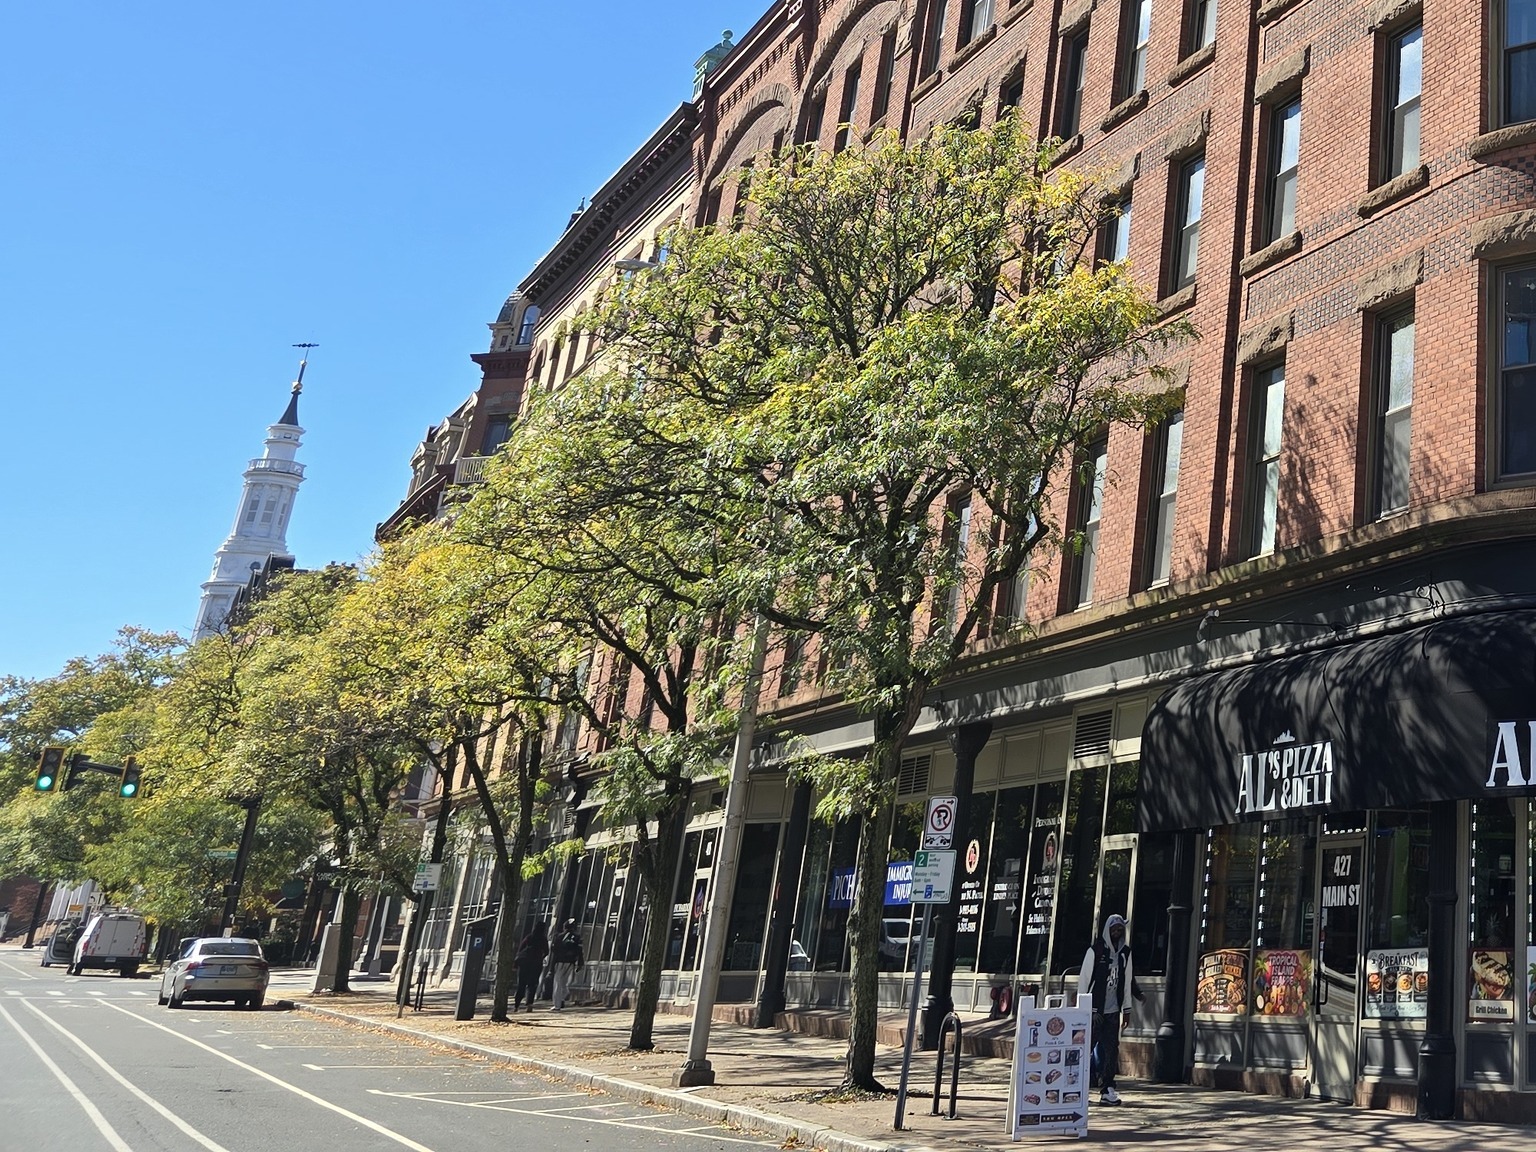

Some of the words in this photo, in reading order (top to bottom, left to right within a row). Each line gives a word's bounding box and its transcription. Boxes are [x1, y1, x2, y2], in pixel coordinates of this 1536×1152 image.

[1282, 741, 1333, 779] PIZZA
[1235, 750, 1281, 814] AL'S
[918, 854, 925, 866] 2
[1333, 855, 1352, 877] 427
[886, 865, 913, 882] IMMIGR
[833, 874, 859, 901] PICH
[1322, 884, 1348, 908] MAIN
[1348, 884, 1361, 906] ST
[474, 937, 482, 947] P
[1268, 955, 1298, 967] TROPICAL
[1377, 952, 1419, 969] BREAKFAST
[1271, 965, 1296, 976] ISLAND
[1270, 975, 1294, 986] FRAPPE
[1475, 1005, 1488, 1014] Grill
[1487, 1005, 1508, 1015] Chicken
